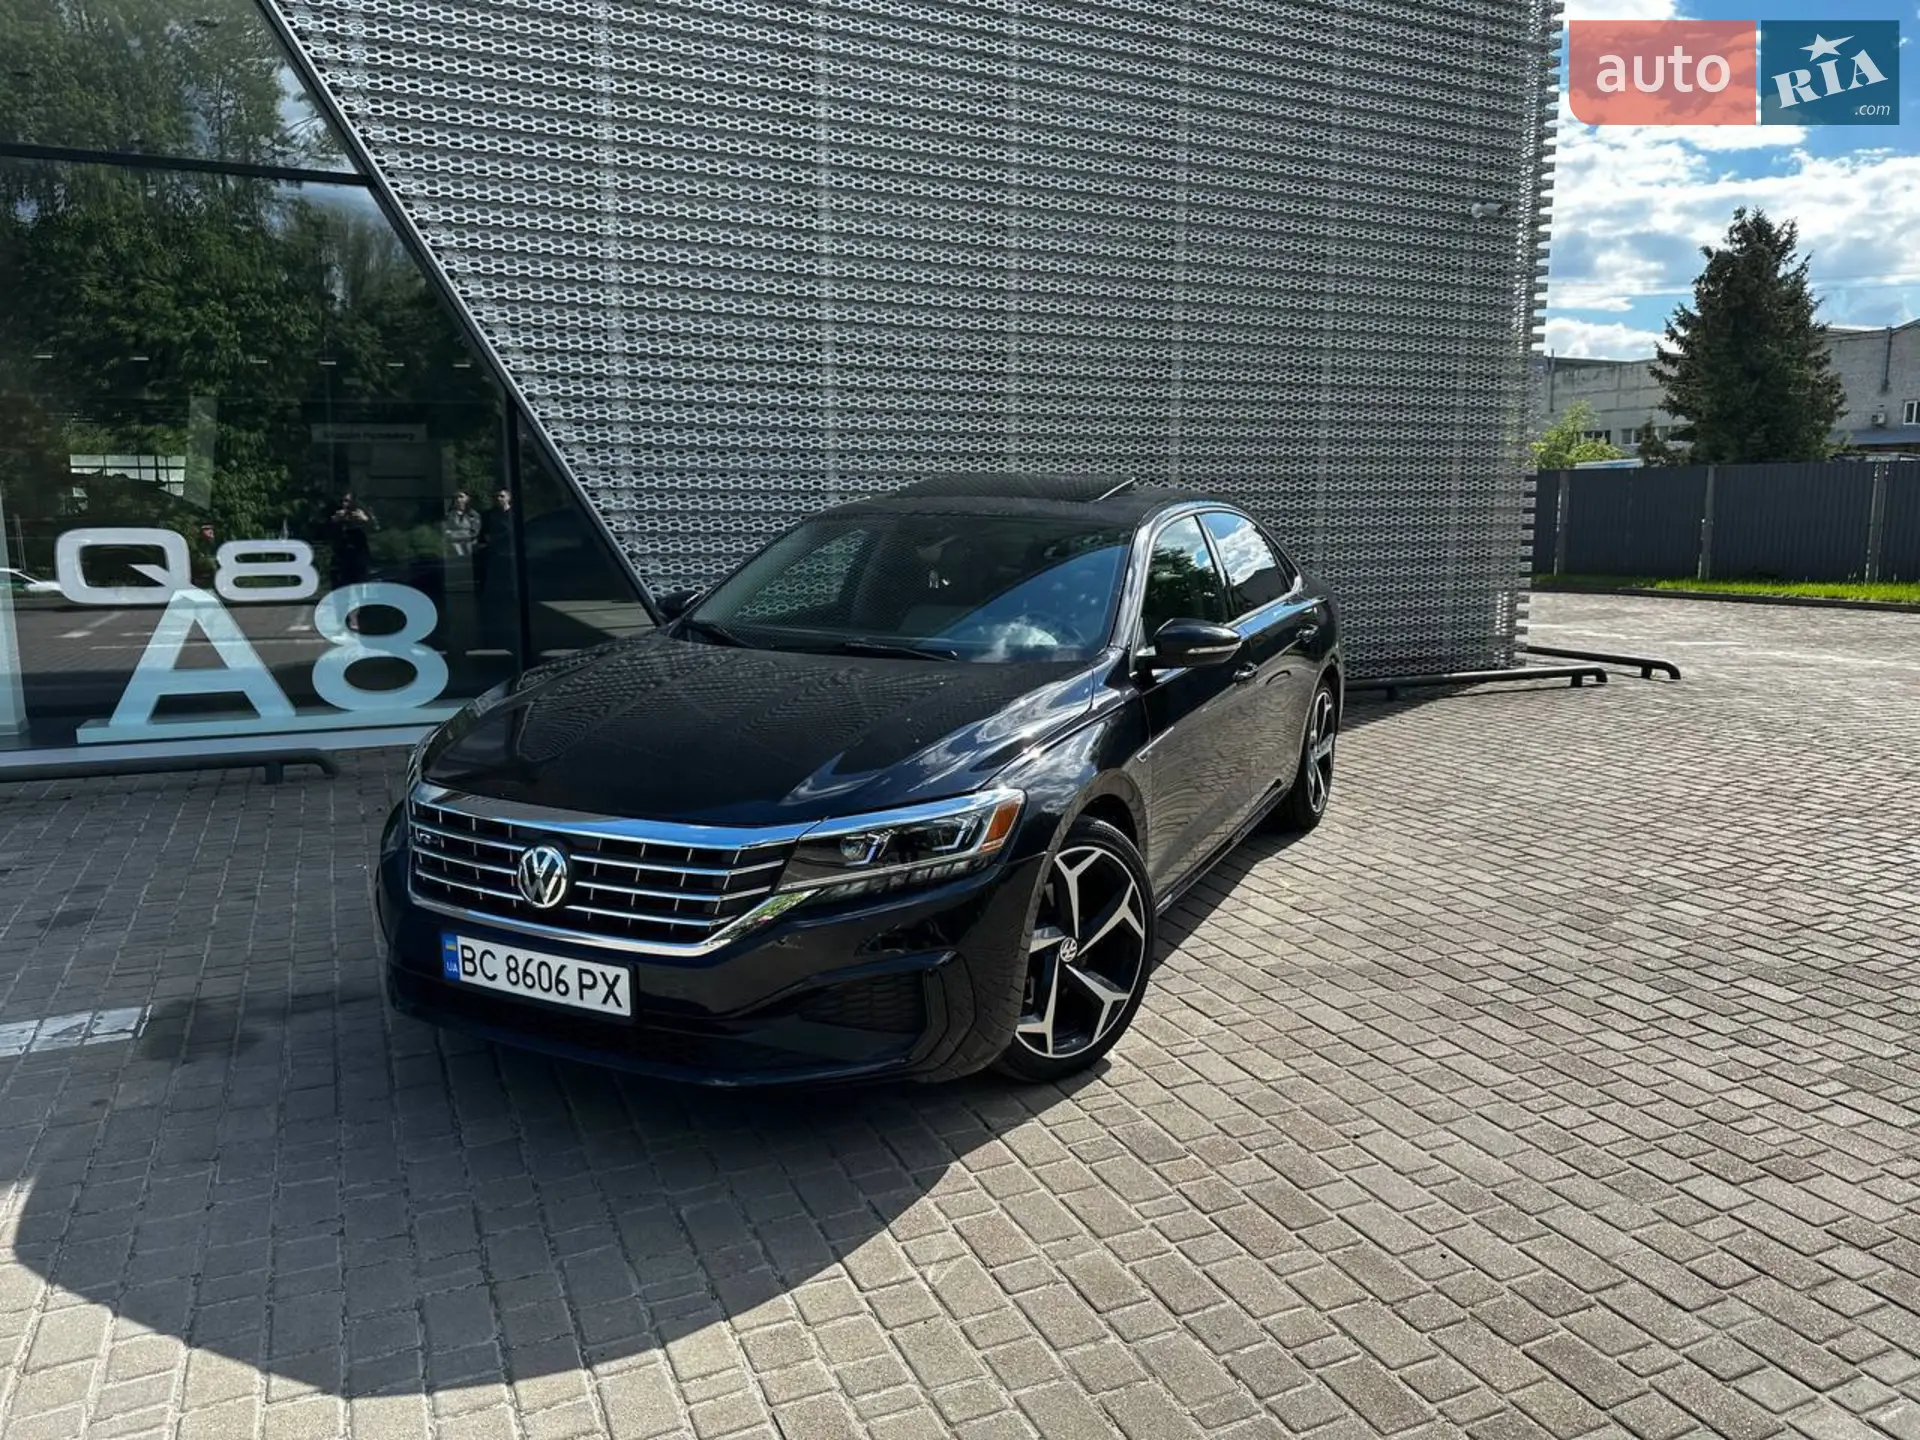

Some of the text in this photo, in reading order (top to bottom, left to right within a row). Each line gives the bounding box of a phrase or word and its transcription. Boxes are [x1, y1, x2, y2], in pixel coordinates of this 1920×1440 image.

[55, 527, 319, 605] Q8
[110, 582, 449, 728] A8
[446, 959, 458, 973] UA
[460, 944, 623, 1009] BC 8606 PX
